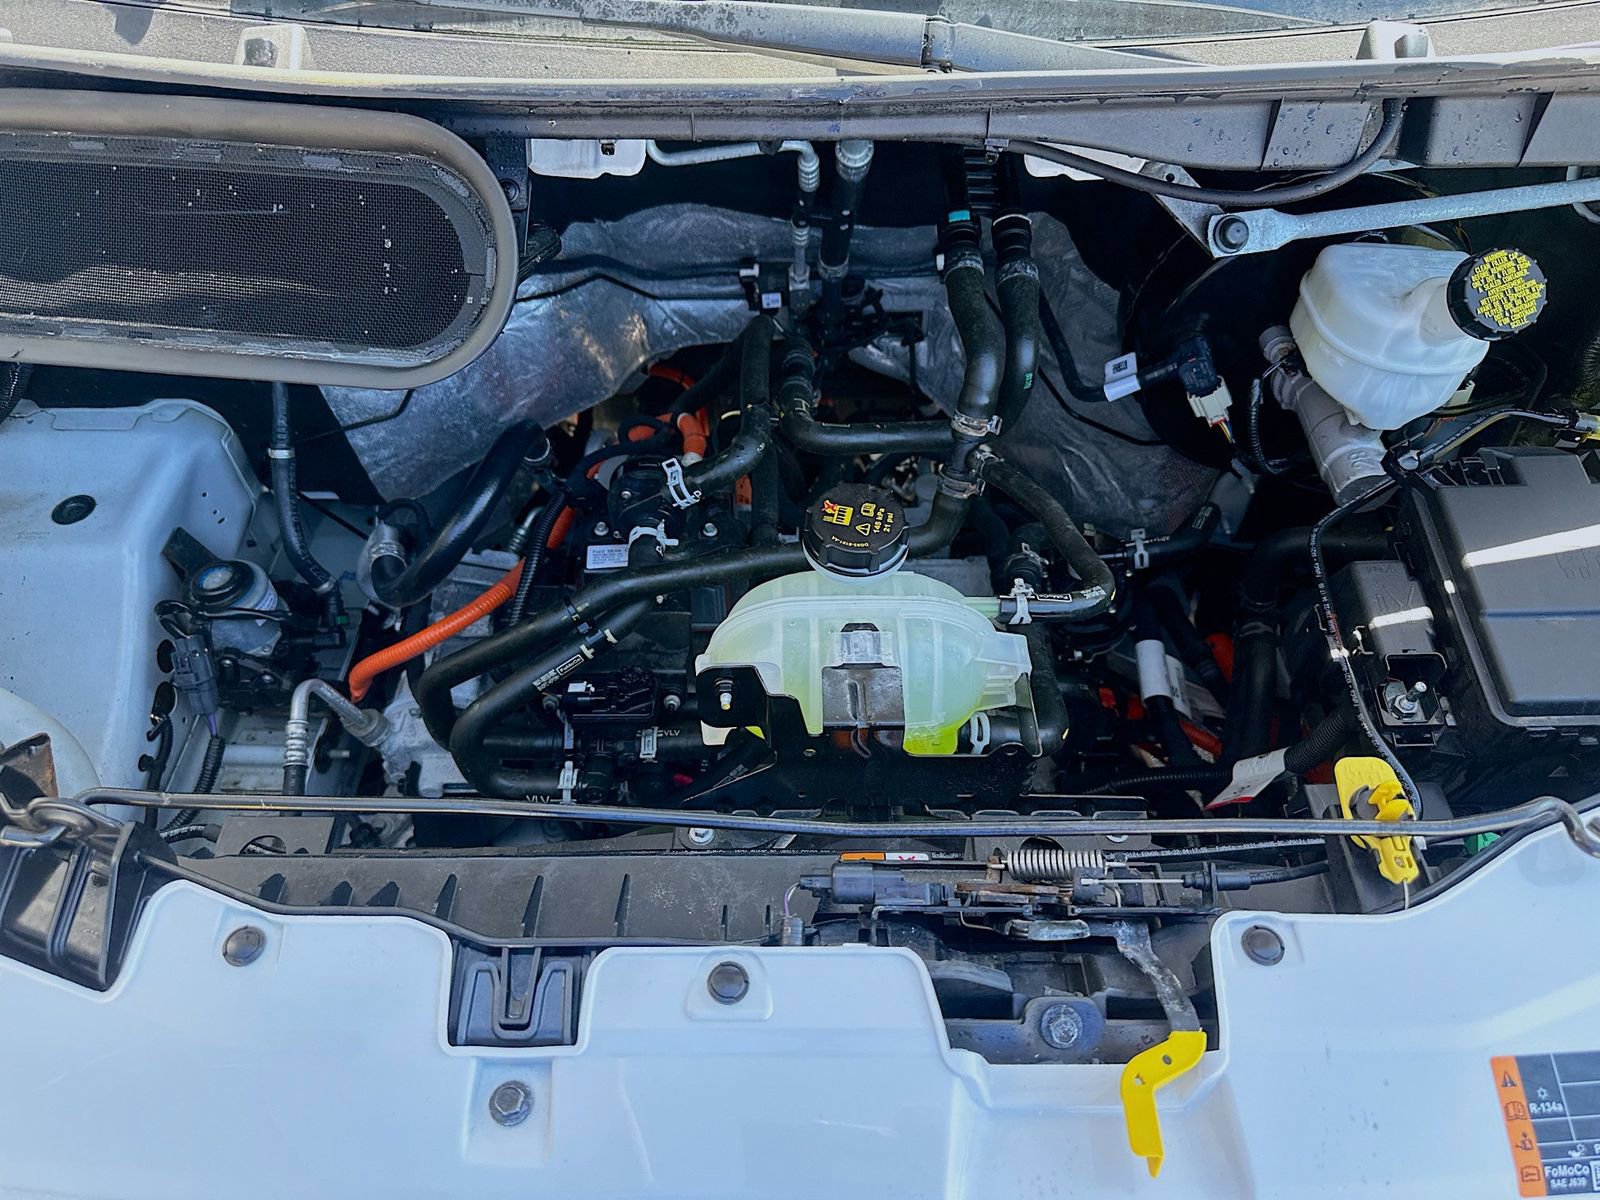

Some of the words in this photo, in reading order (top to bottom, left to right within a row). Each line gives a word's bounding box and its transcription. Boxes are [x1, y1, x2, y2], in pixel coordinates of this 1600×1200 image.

[1475, 263, 1490, 272] CLEAN
[1491, 257, 1507, 266] FILLER
[1471, 271, 1489, 281] BEFORE
[1472, 279, 1485, 288] ONLY
[1502, 267, 1516, 276] FLUID
[1517, 262, 1530, 270] FROM
[1484, 280, 1501, 290] SEALED
[1477, 304, 1492, 314] AVANT
[876, 508, 886, 520] kPa
[873, 520, 882, 534] 145
[883, 524, 892, 533] 21
[1529, 1101, 1564, 1114] R-134a
[1544, 1163, 1590, 1178] FoMoCo
[1550, 1178, 1568, 1188] SAE
